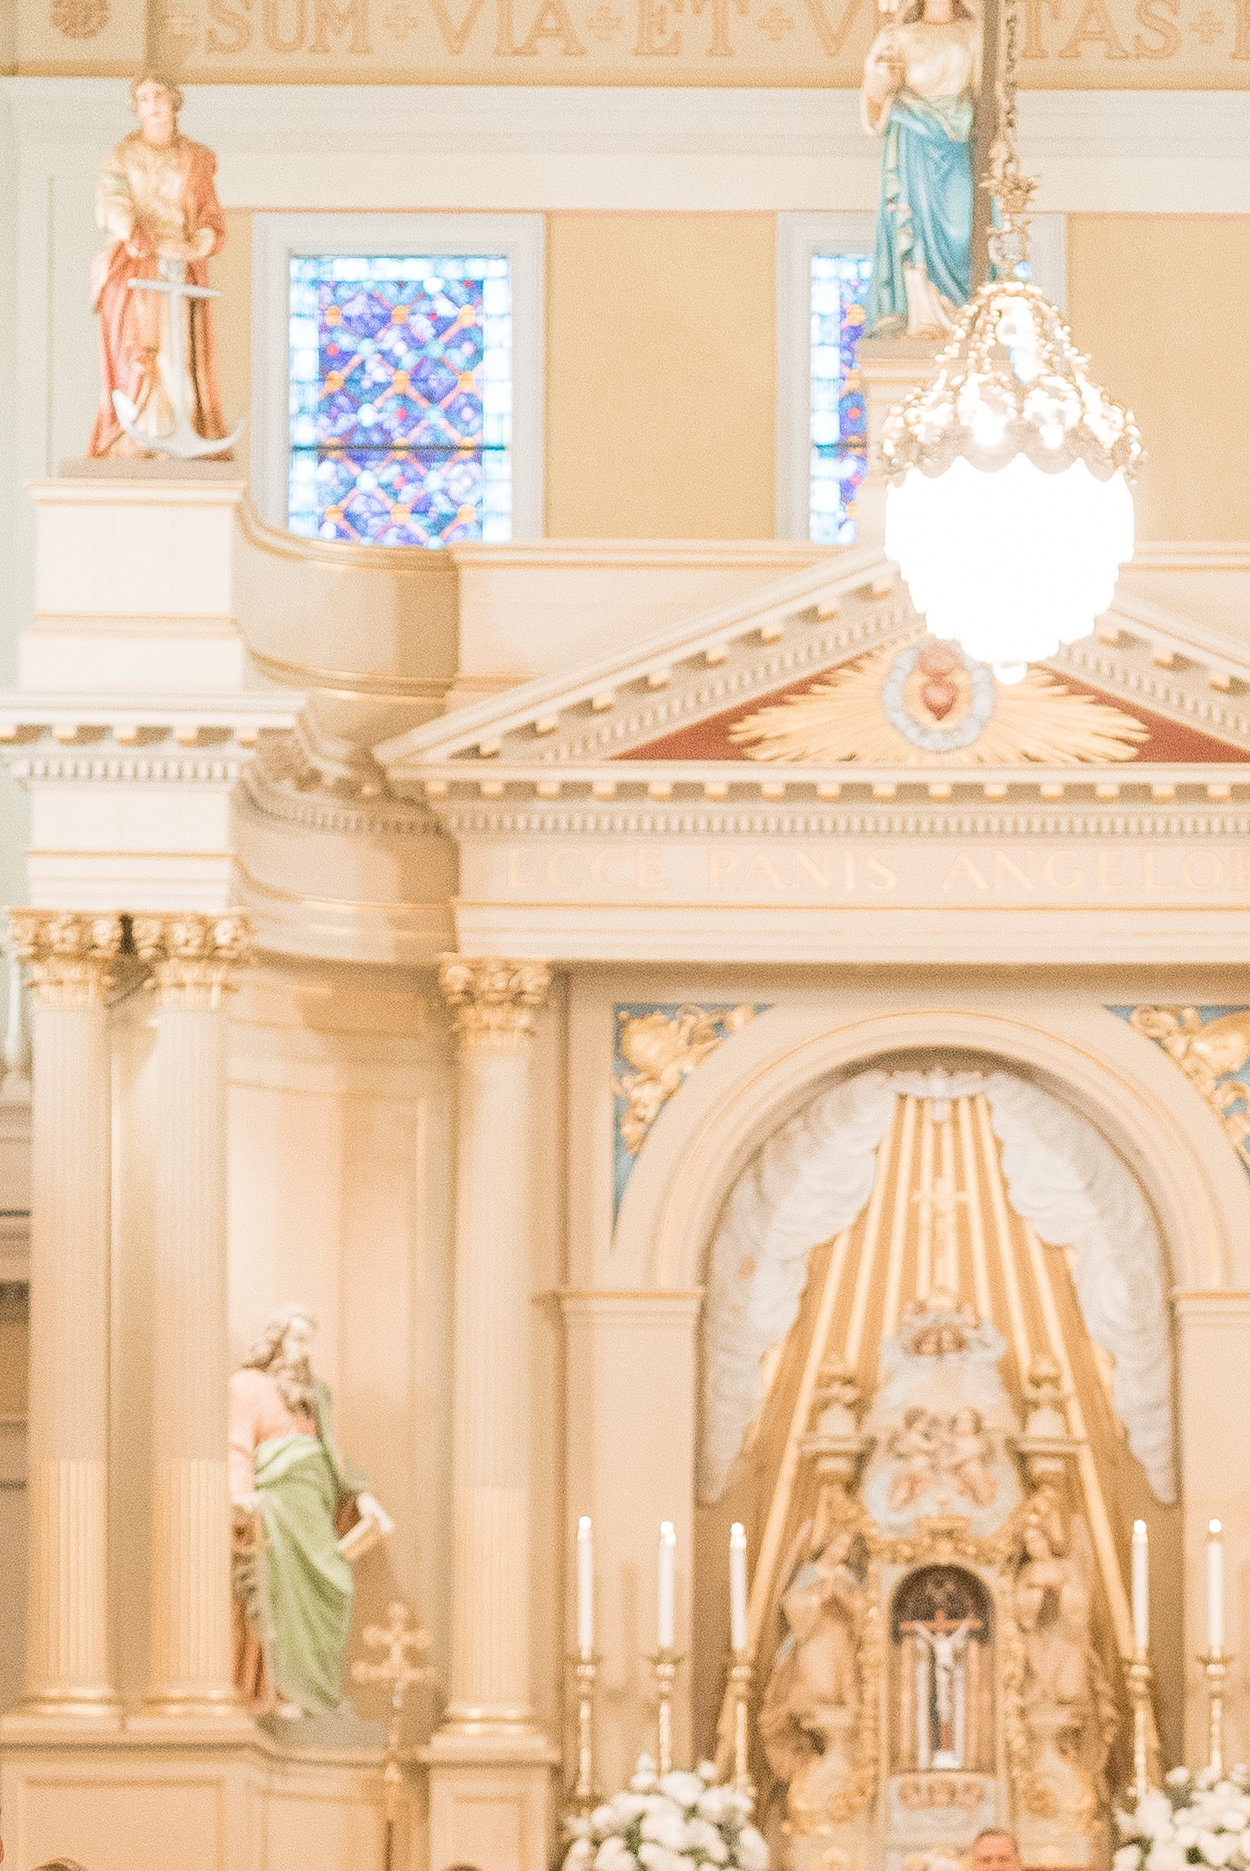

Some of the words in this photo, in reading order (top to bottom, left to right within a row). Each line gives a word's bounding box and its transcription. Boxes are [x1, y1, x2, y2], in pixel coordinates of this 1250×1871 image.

[205, 0, 373, 55] SUM
[428, 0, 588, 57] VIA
[632, 0, 750, 57] ET
[705, 848, 899, 893] PANIS
